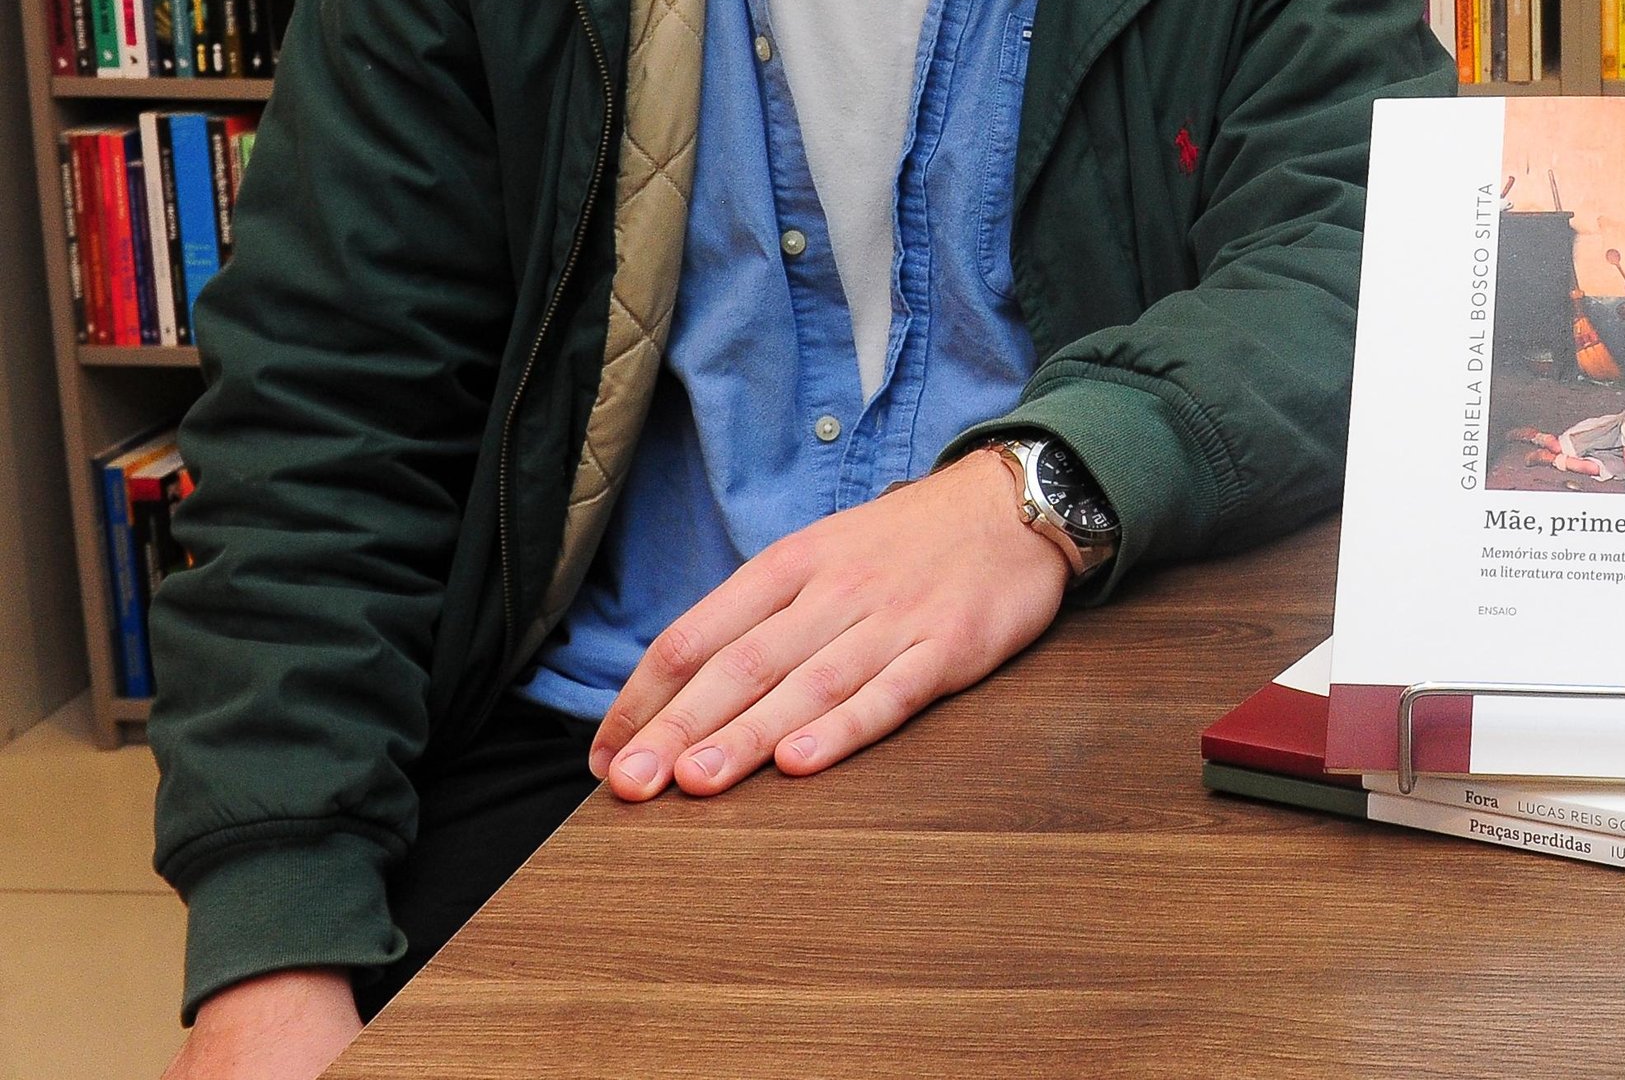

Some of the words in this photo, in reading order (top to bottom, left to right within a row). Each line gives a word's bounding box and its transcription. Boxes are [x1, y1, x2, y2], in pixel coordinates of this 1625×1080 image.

[1475, 183, 1493, 239] SITTA
[1470, 248, 1490, 321] BOSCO
[1467, 330, 1485, 372] DAL
[1461, 381, 1483, 490] GABRIELA
[1483, 509, 1543, 535] Mãe,
[1481, 546, 1549, 562] Memórias
[1551, 547, 1586, 562] sobre
[1588, 552, 1598, 562] a
[1480, 568, 1498, 578] na
[1500, 566, 1564, 580] literatura
[1478, 606, 1517, 617] ENSAIO
[1465, 790, 1500, 810] Fora
[1517, 800, 1566, 821] LUCAS
[1570, 809, 1603, 828] REIS
[1469, 818, 1521, 843] Praças
[1522, 829, 1593, 855] perdidas
